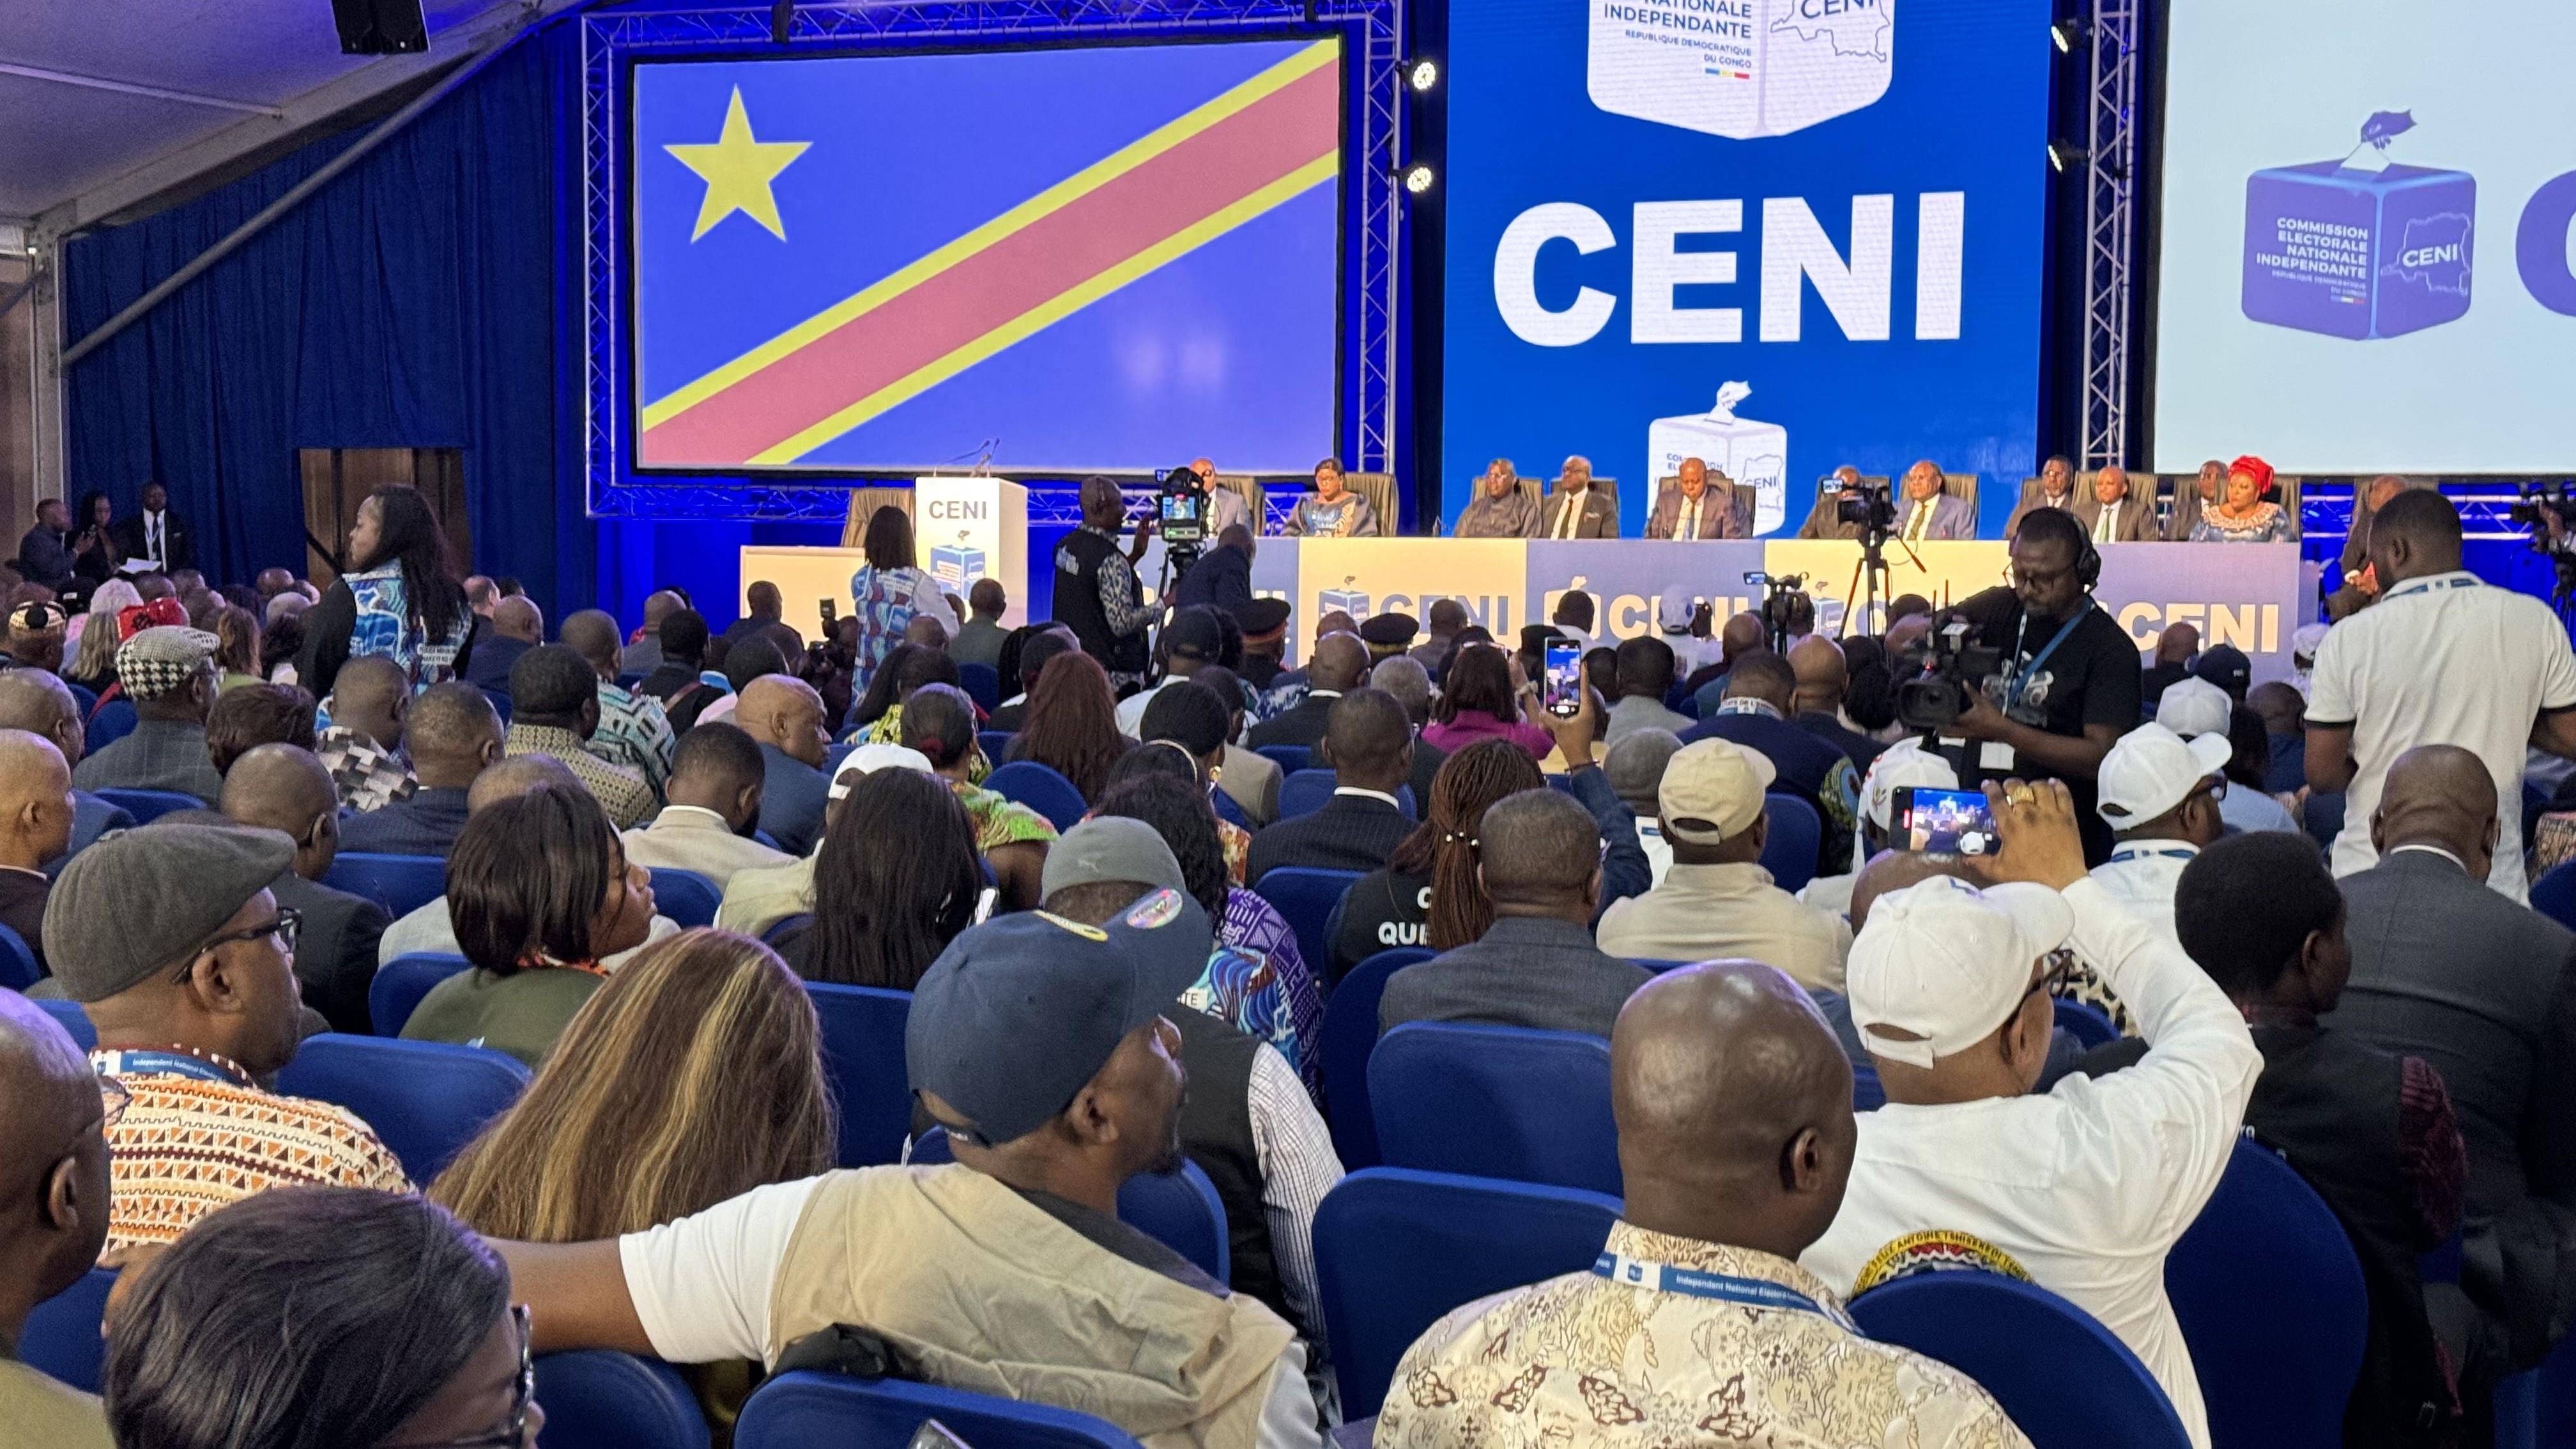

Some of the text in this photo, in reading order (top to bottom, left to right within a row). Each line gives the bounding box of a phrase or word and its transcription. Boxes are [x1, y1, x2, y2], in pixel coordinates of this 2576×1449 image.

[1644, 0, 1752, 19] ATIONALE
[1801, 0, 1873, 19] CE
[1604, 5, 1752, 39] INDEPENDANTE
[1625, 29, 1752, 56] REPUBLIQUE DEMOCRATIQUE
[1704, 54, 1752, 68] DU CONGO
[2277, 217, 2368, 240] COMMISSION
[2278, 230, 2368, 253] ELECTORALE
[2257, 252, 2366, 279] INDEPENDANTE
[2287, 245, 2367, 266] NATIONALE
[2402, 243, 2458, 268] CENI
[1494, 191, 1965, 348] CENI
[929, 500, 986, 519] CENI
[2117, 602, 2279, 653] CENI
[1676, 1273, 1724, 1291] Independent
[1725, 1282, 1757, 1296] National
